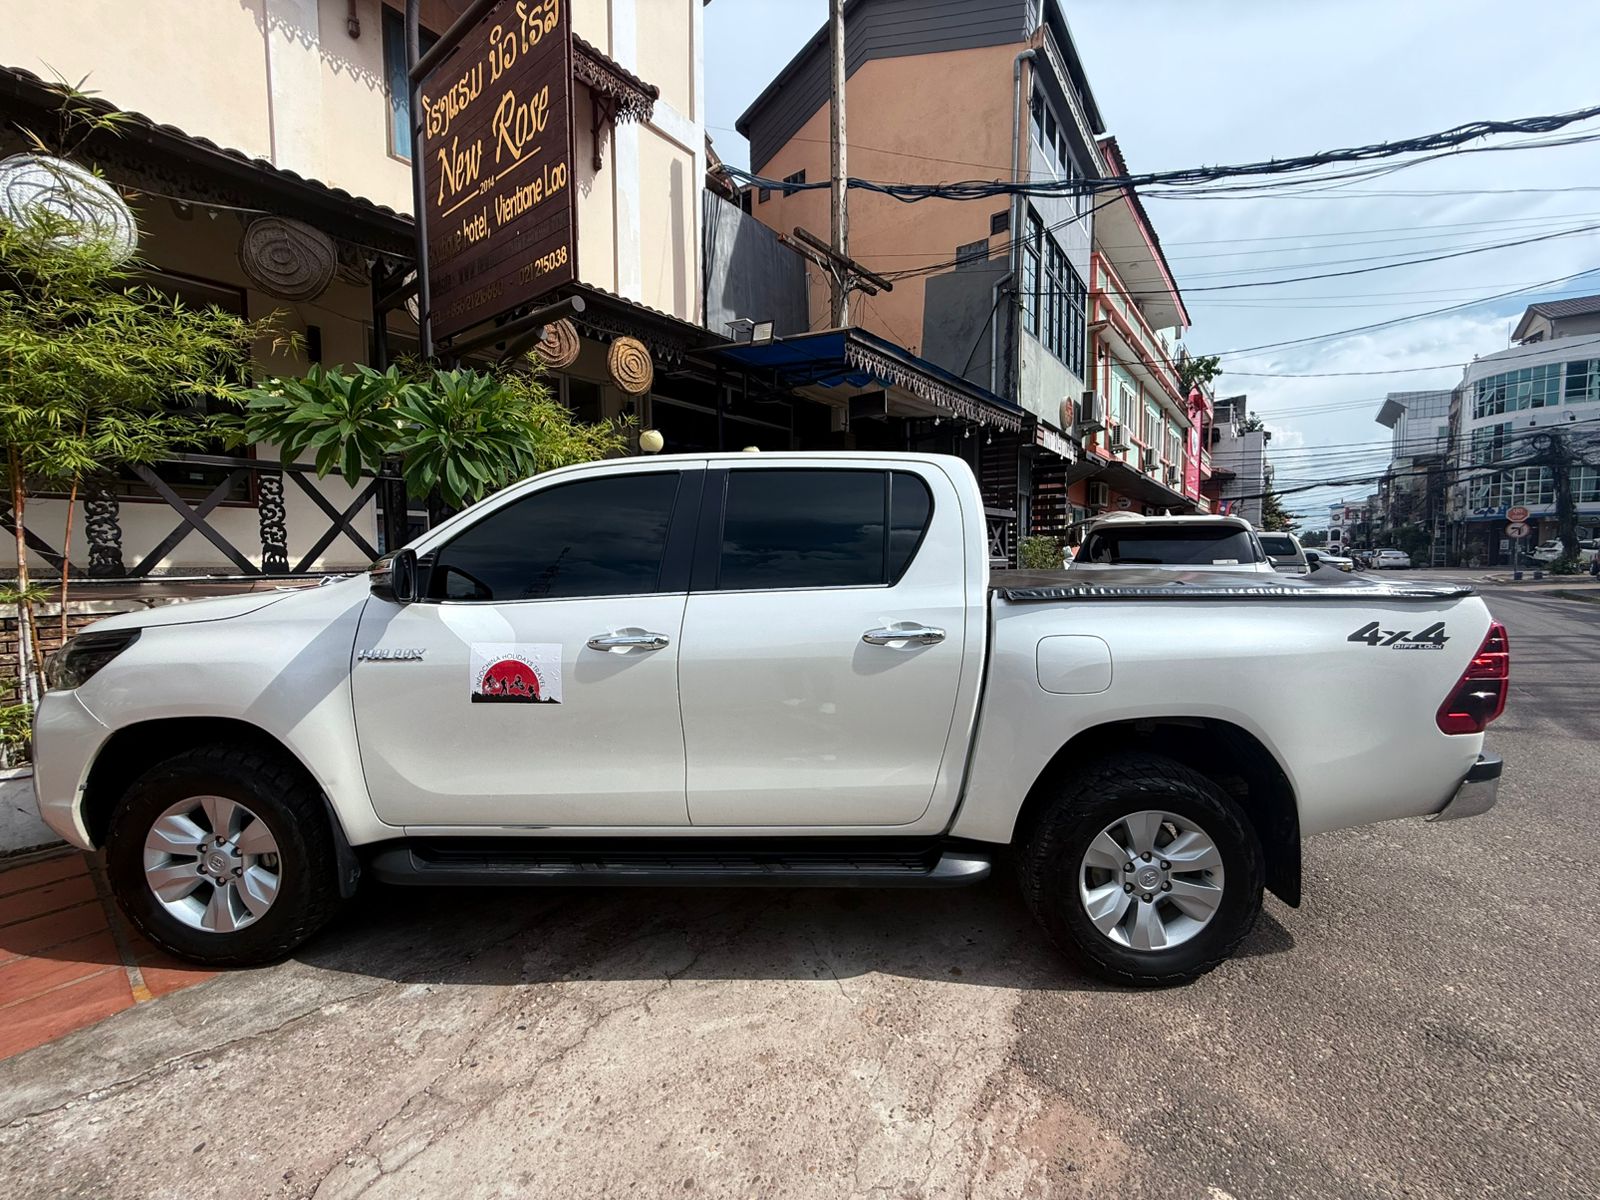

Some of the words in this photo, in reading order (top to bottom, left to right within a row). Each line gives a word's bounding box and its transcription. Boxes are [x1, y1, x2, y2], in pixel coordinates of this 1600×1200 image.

[437, 135, 482, 206] New
[491, 85, 550, 164] Rose
[479, 175, 495, 195] 2014
[495, 177, 543, 226] Vientiane
[543, 162, 566, 198] Lao
[534, 245, 568, 278] 215038
